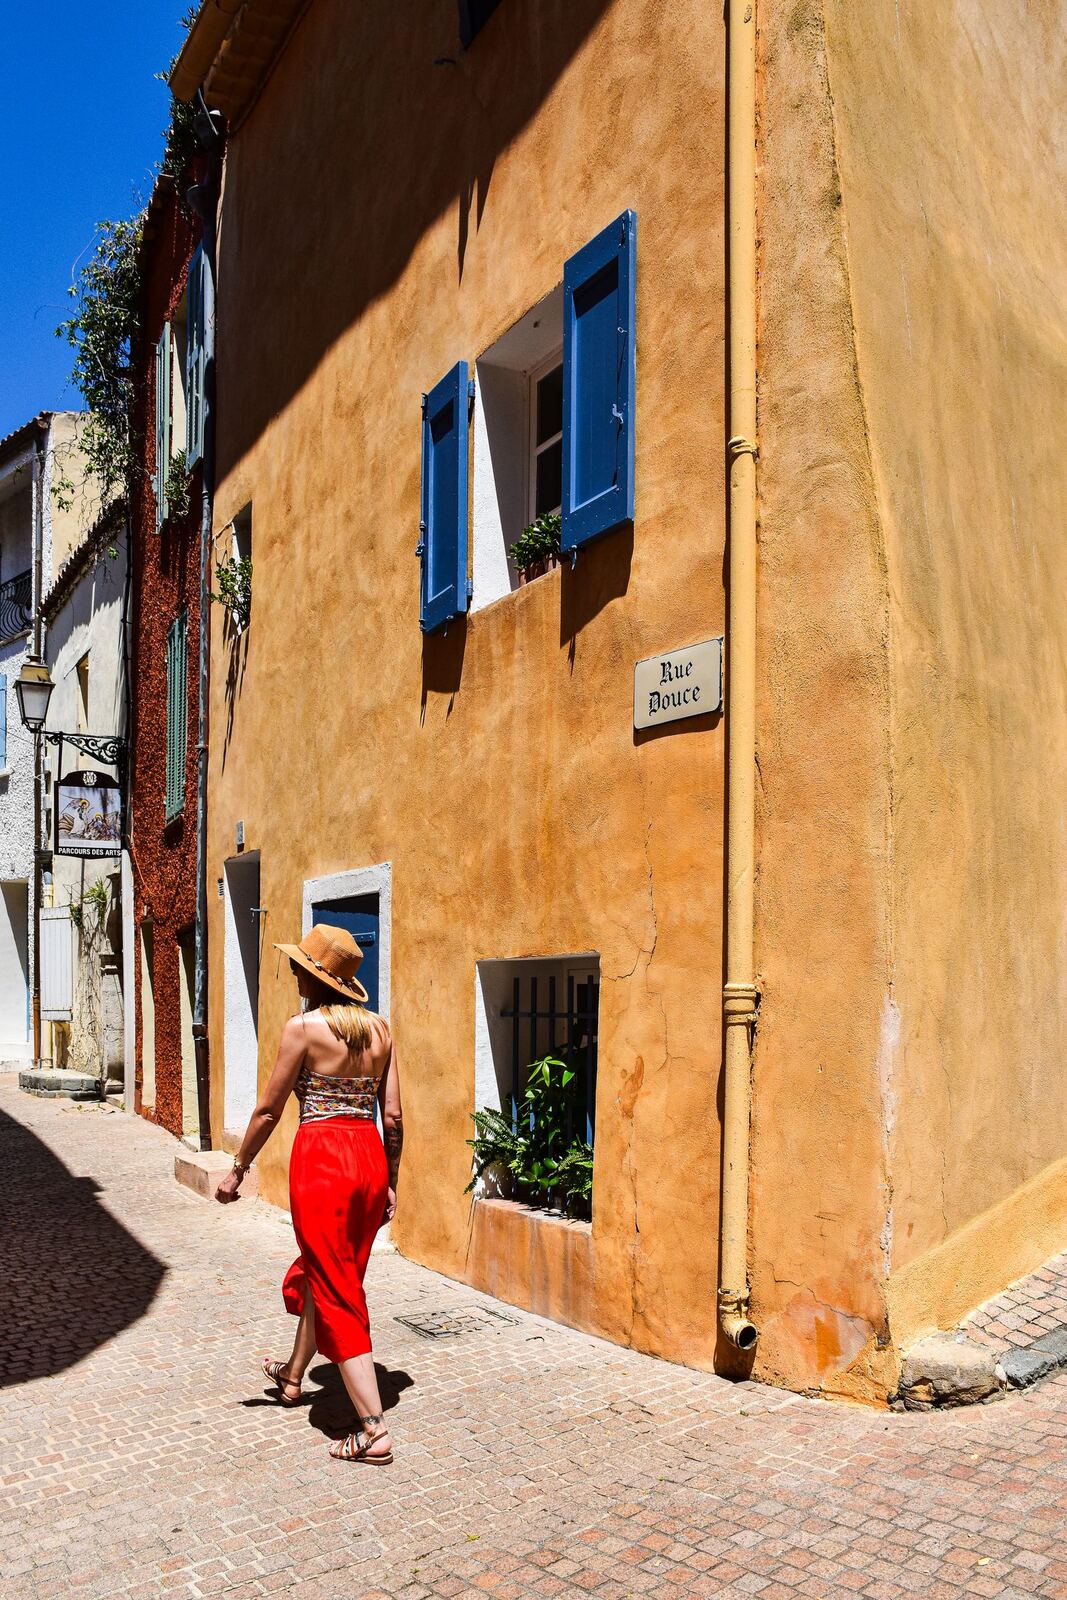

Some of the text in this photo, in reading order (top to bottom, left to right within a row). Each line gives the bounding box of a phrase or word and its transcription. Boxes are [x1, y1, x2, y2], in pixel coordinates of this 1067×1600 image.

[660, 661, 693, 686] Rue
[649, 686, 700, 716] Douce
[58, 847, 91, 855] PARCOURS
